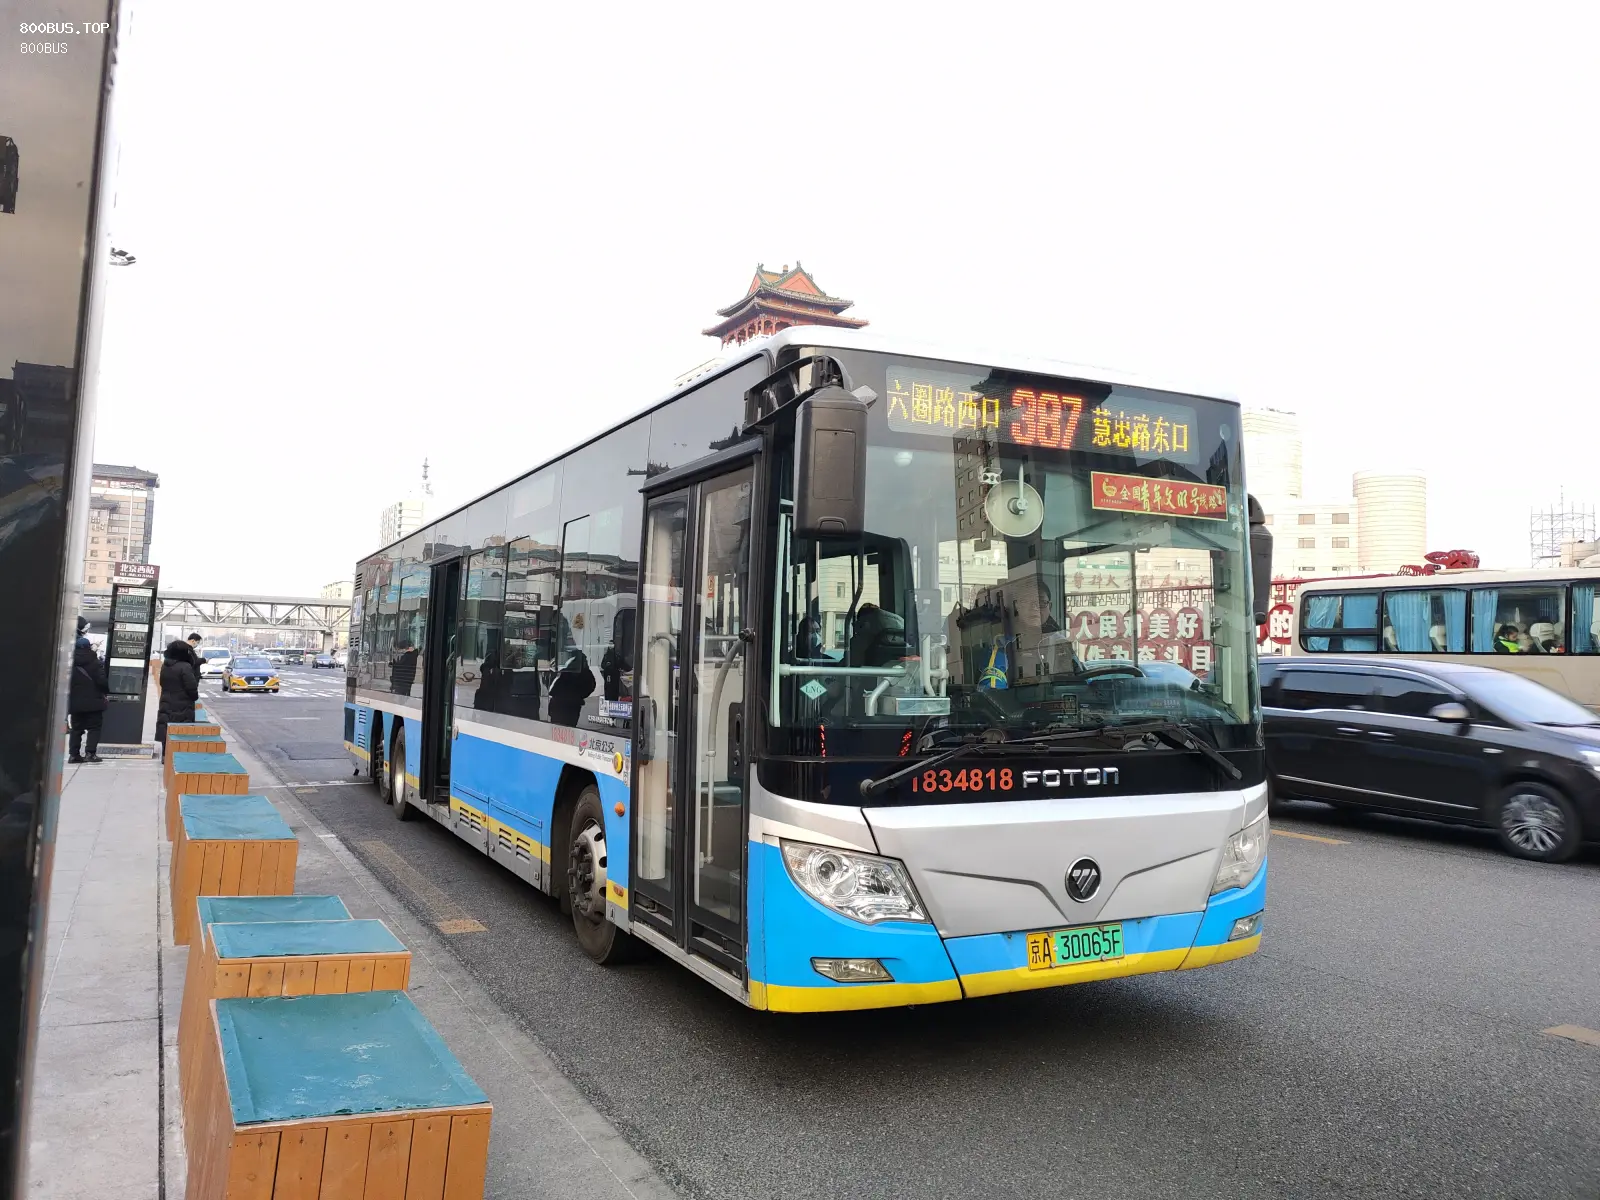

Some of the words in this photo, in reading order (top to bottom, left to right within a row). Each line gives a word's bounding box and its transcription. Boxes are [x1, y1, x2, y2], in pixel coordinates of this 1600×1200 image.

[887, 379, 1000, 430] 六圈路西口
[1011, 388, 1083, 449] 387
[119, 563, 155, 575] 北京西站
[588, 738, 615, 754] 北京公交
[912, 768, 1014, 792] 1834818
[1022, 767, 1120, 788] FOTON
